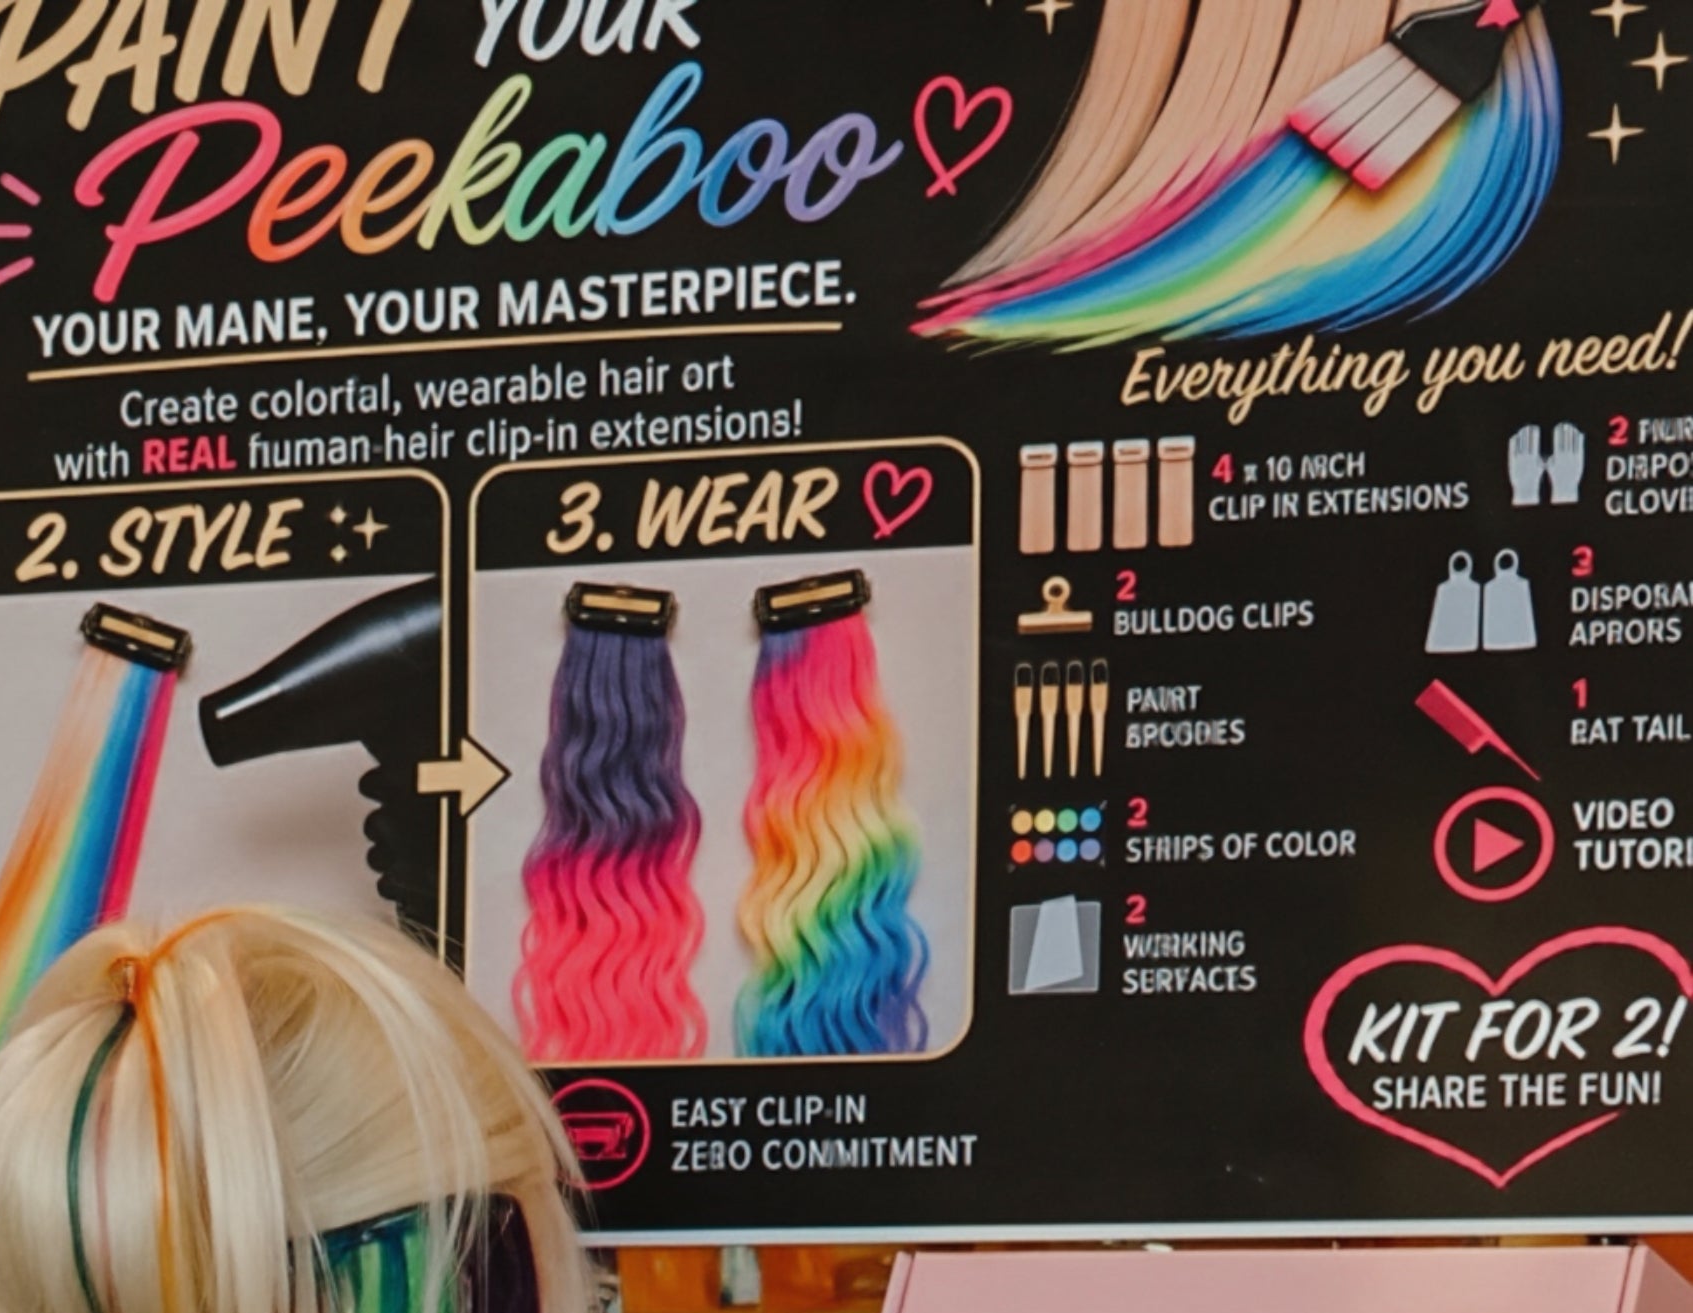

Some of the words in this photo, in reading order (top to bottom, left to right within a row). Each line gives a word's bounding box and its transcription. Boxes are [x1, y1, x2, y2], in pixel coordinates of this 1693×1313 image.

[76, 62, 903, 301] Peekaboo
[32, 309, 161, 359] YOUR
[175, 298, 328, 350] MANE,
[346, 287, 478, 338] YOUR
[497, 259, 856, 328] MASTERPIECE.
[1120, 334, 1410, 426] Everything
[1416, 339, 1525, 414] you
[1536, 310, 1693, 380] need!
[120, 388, 239, 428] Create
[416, 361, 588, 410] wearable
[598, 355, 670, 396] hair
[54, 443, 130, 482] with
[142, 436, 238, 474] REAL
[466, 416, 580, 464] clip-in
[589, 400, 804, 450] extensions!
[1608, 415, 1629, 446] 2
[1211, 454, 1235, 483] 4
[545, 482, 615, 553] 3.
[634, 467, 841, 546] WEAR
[1208, 495, 1265, 521] CLIP
[1306, 481, 1470, 517] EXTENSIONS
[14, 511, 78, 583] 2.
[97, 497, 306, 573] STYLE
[1571, 545, 1594, 577] 3
[1115, 571, 1136, 600] 2
[1113, 609, 1235, 636] BULLDOG
[1243, 602, 1315, 629] CLIPS
[1571, 677, 1588, 709] 1
[1631, 712, 1692, 742] TAIL
[1127, 797, 1148, 828] 2
[1573, 797, 1675, 832] VIDEO
[1222, 832, 1258, 859] OF
[1264, 828, 1357, 858] COLOR
[1125, 893, 1147, 924] 2
[1346, 1002, 1458, 1065] KIT
[1465, 999, 1600, 1061] FOR
[1613, 994, 1687, 1059] 2!
[1372, 1076, 1487, 1110] SHARE
[1498, 1074, 1567, 1106] THE
[1578, 1071, 1662, 1105] FUN!
[671, 1097, 747, 1128] EASY
